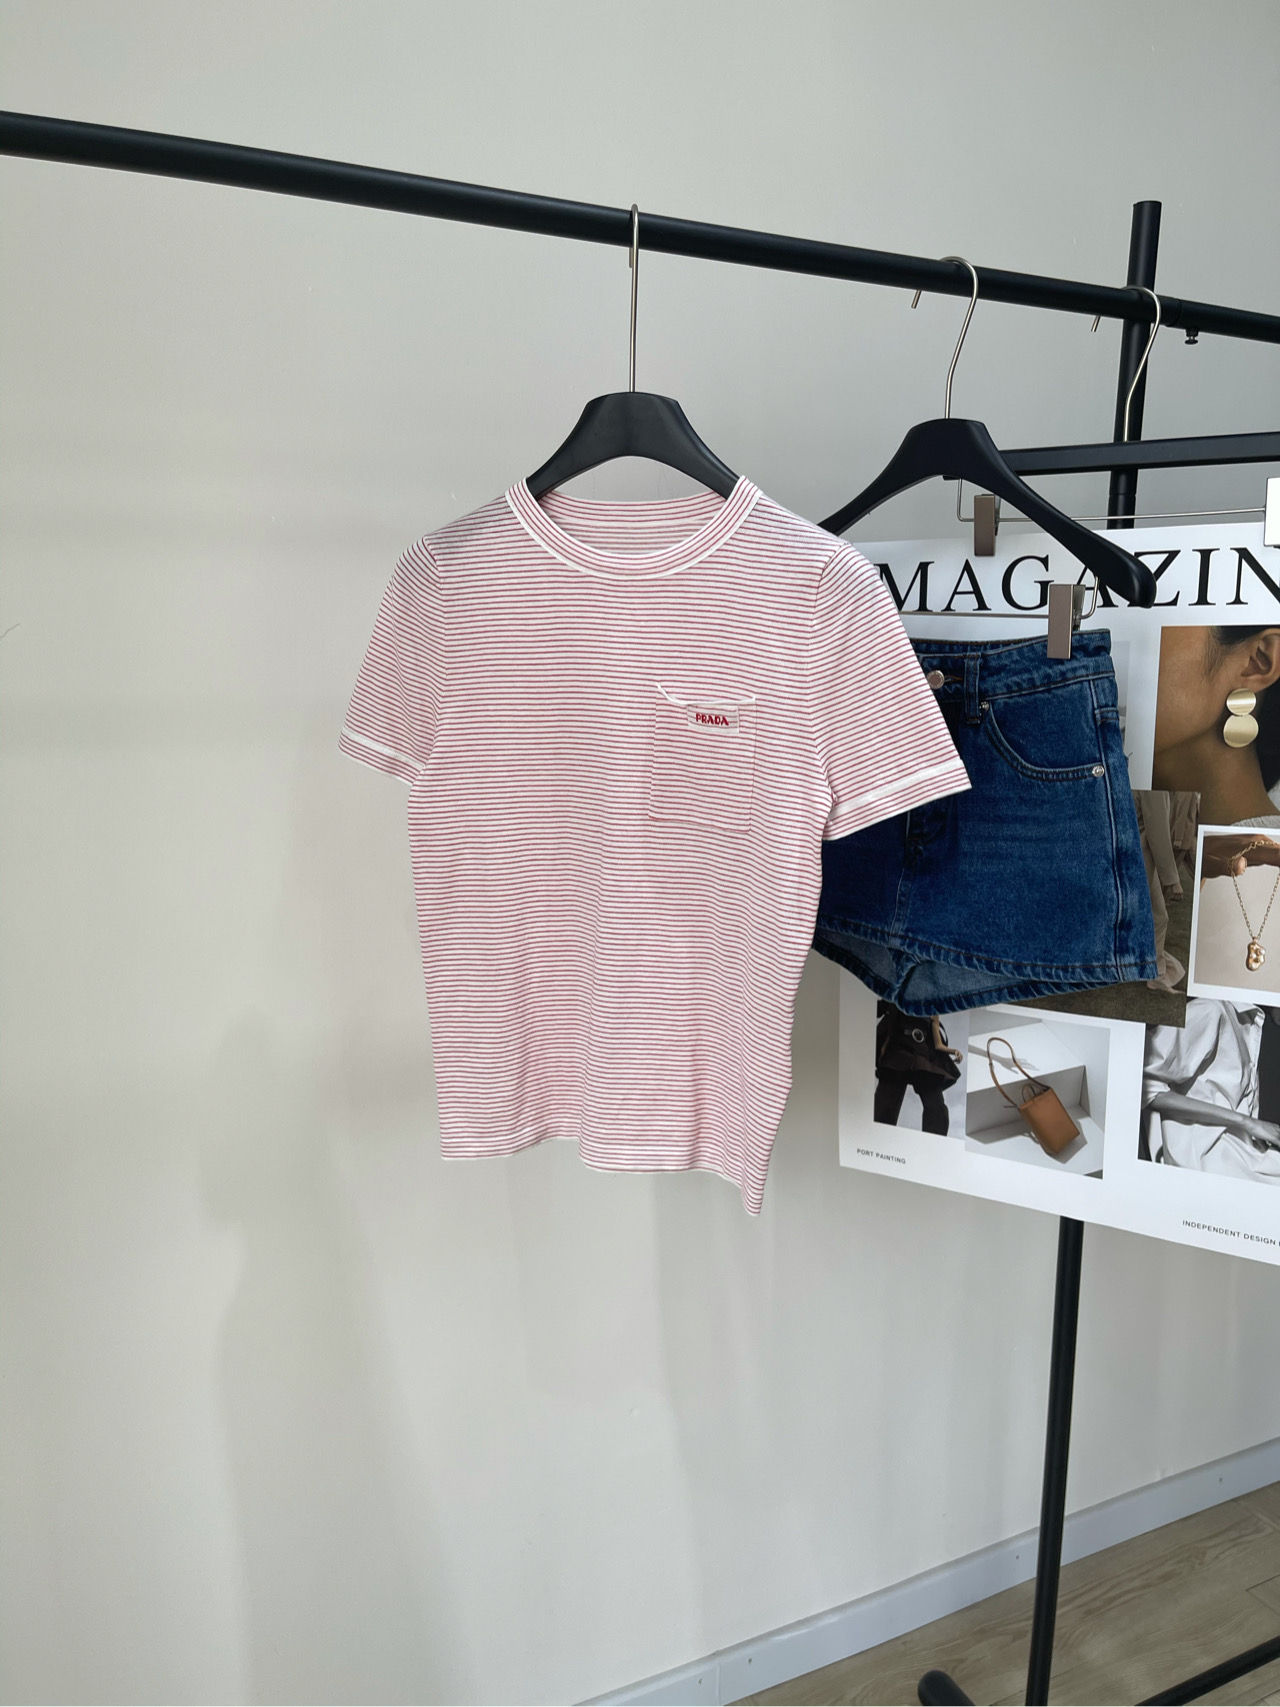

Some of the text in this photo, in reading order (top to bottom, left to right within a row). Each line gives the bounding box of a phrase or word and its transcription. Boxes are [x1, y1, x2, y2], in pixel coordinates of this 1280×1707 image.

[695, 712, 730, 726] PRADA
[856, 1148, 906, 1165] PORT PAINTING
[1182, 1219, 1241, 1238] INDEPENDENT
[1243, 1233, 1276, 1246] DESIGN
